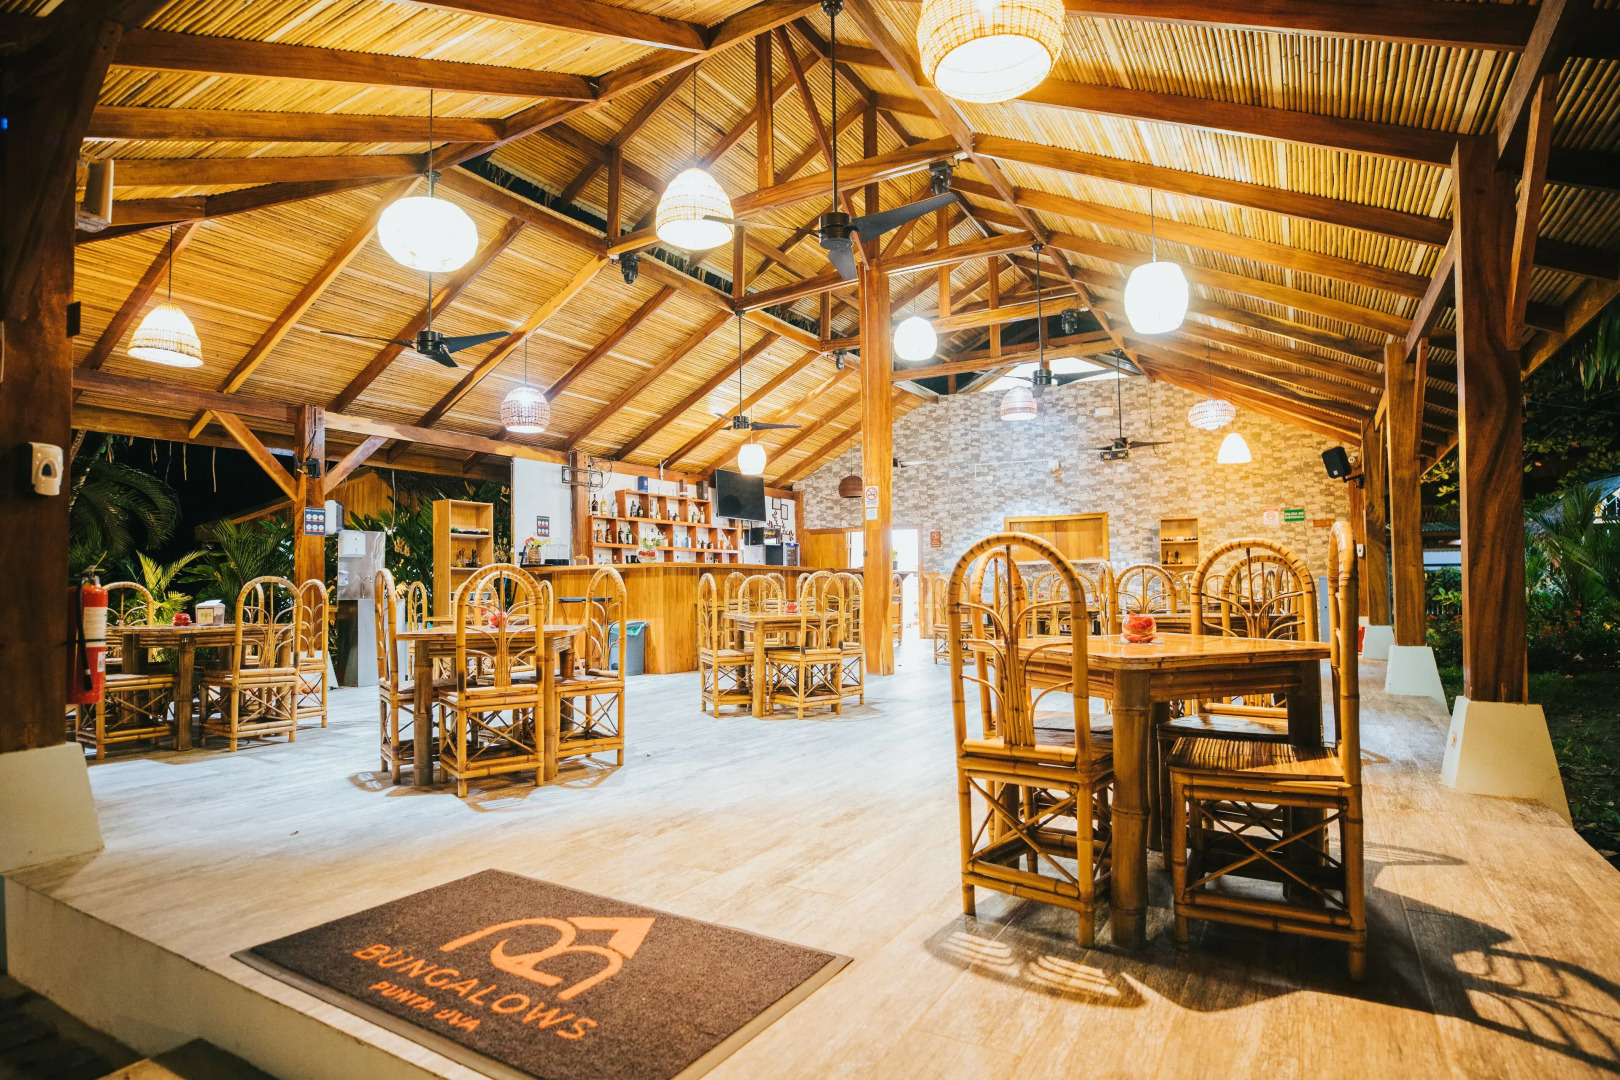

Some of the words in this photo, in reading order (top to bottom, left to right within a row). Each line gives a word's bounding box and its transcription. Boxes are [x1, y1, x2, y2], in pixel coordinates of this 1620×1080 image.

[353, 943, 598, 1040] BUNGALOWS
[369, 980, 436, 1012] PUNTA
[434, 1009, 481, 1032] UVA
